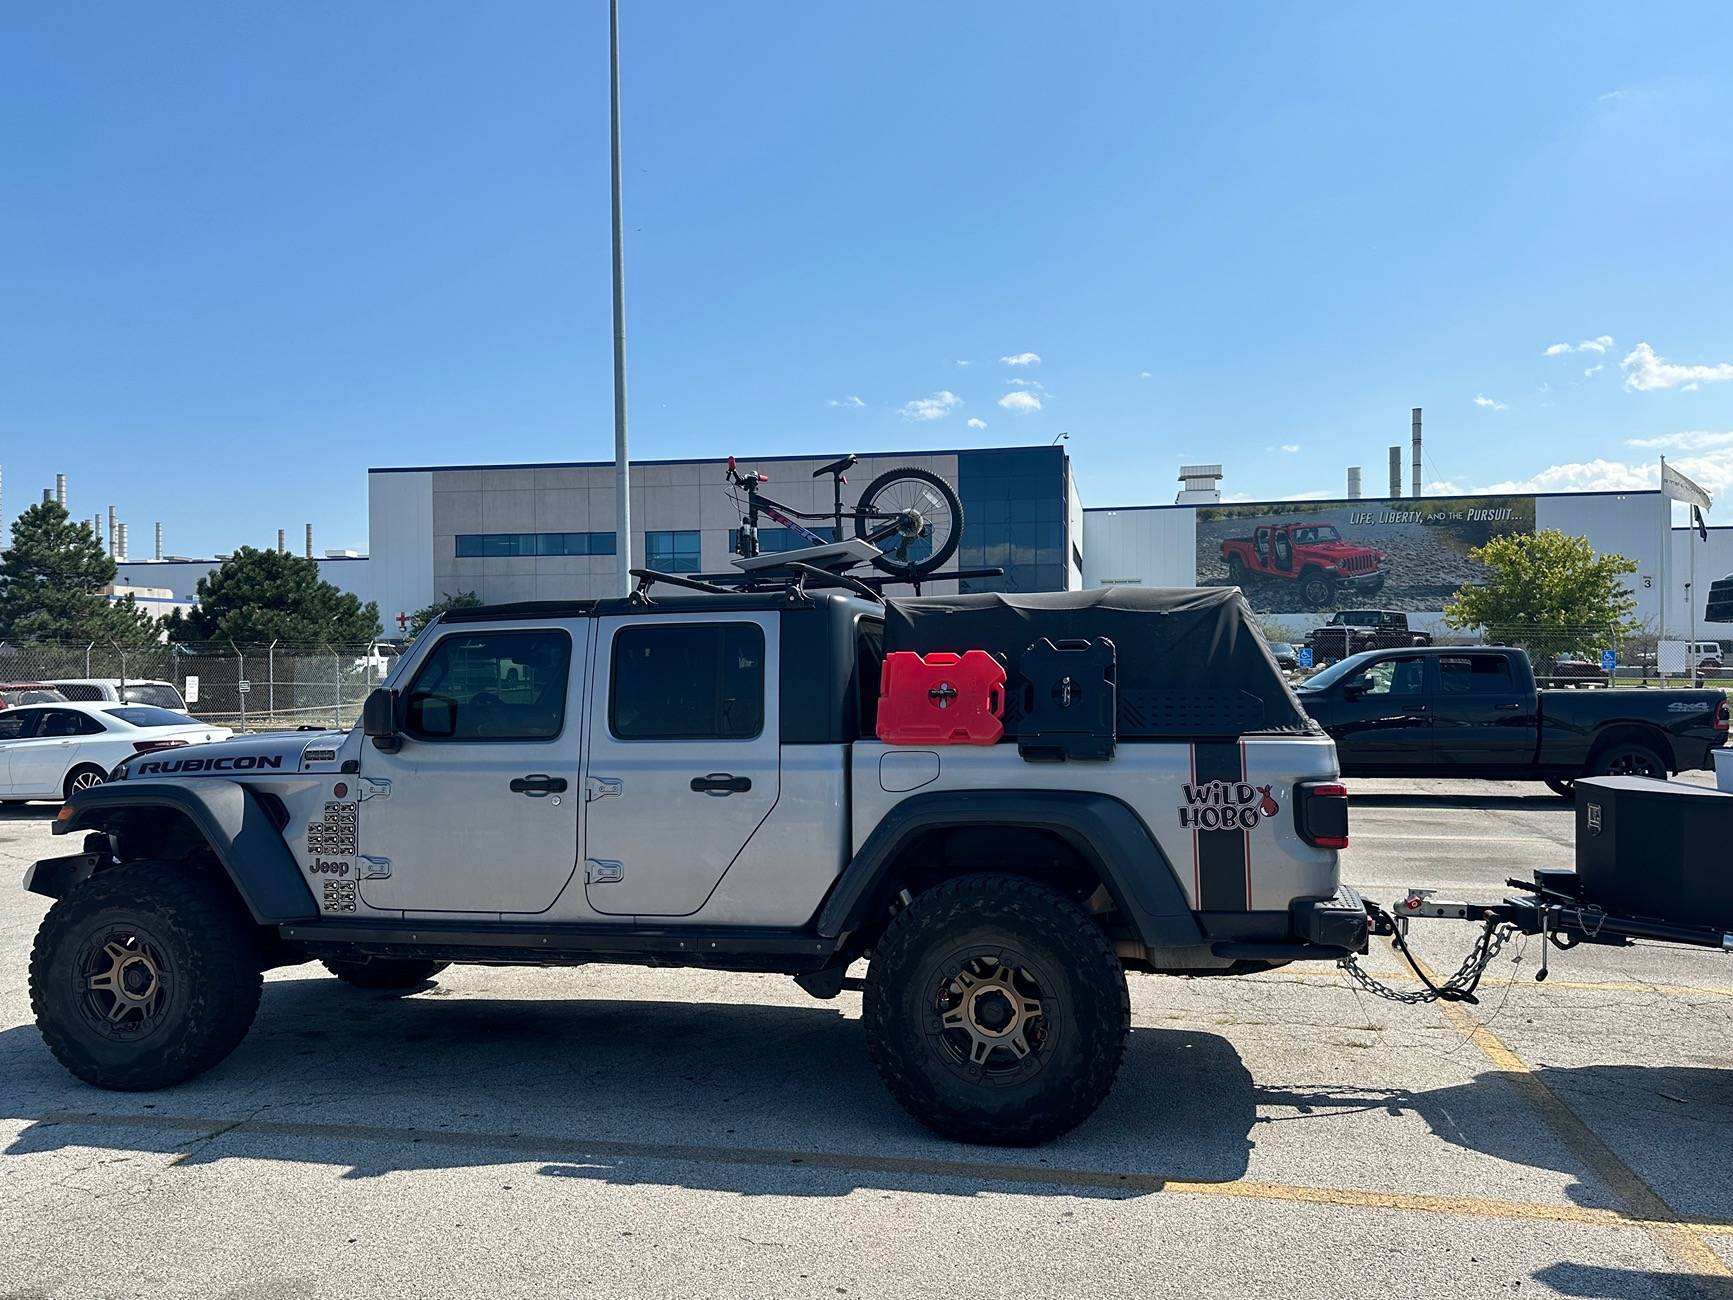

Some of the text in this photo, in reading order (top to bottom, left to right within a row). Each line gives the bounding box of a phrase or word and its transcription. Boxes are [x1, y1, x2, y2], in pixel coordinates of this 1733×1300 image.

[1350, 508, 1522, 525] LIFE, LIBERTY, AND THE PURSUIT...
[1644, 579, 1652, 588] 3
[138, 755, 283, 775] RUBICON
[1179, 806, 1259, 829] HOBO
[309, 857, 349, 877] Jeep
